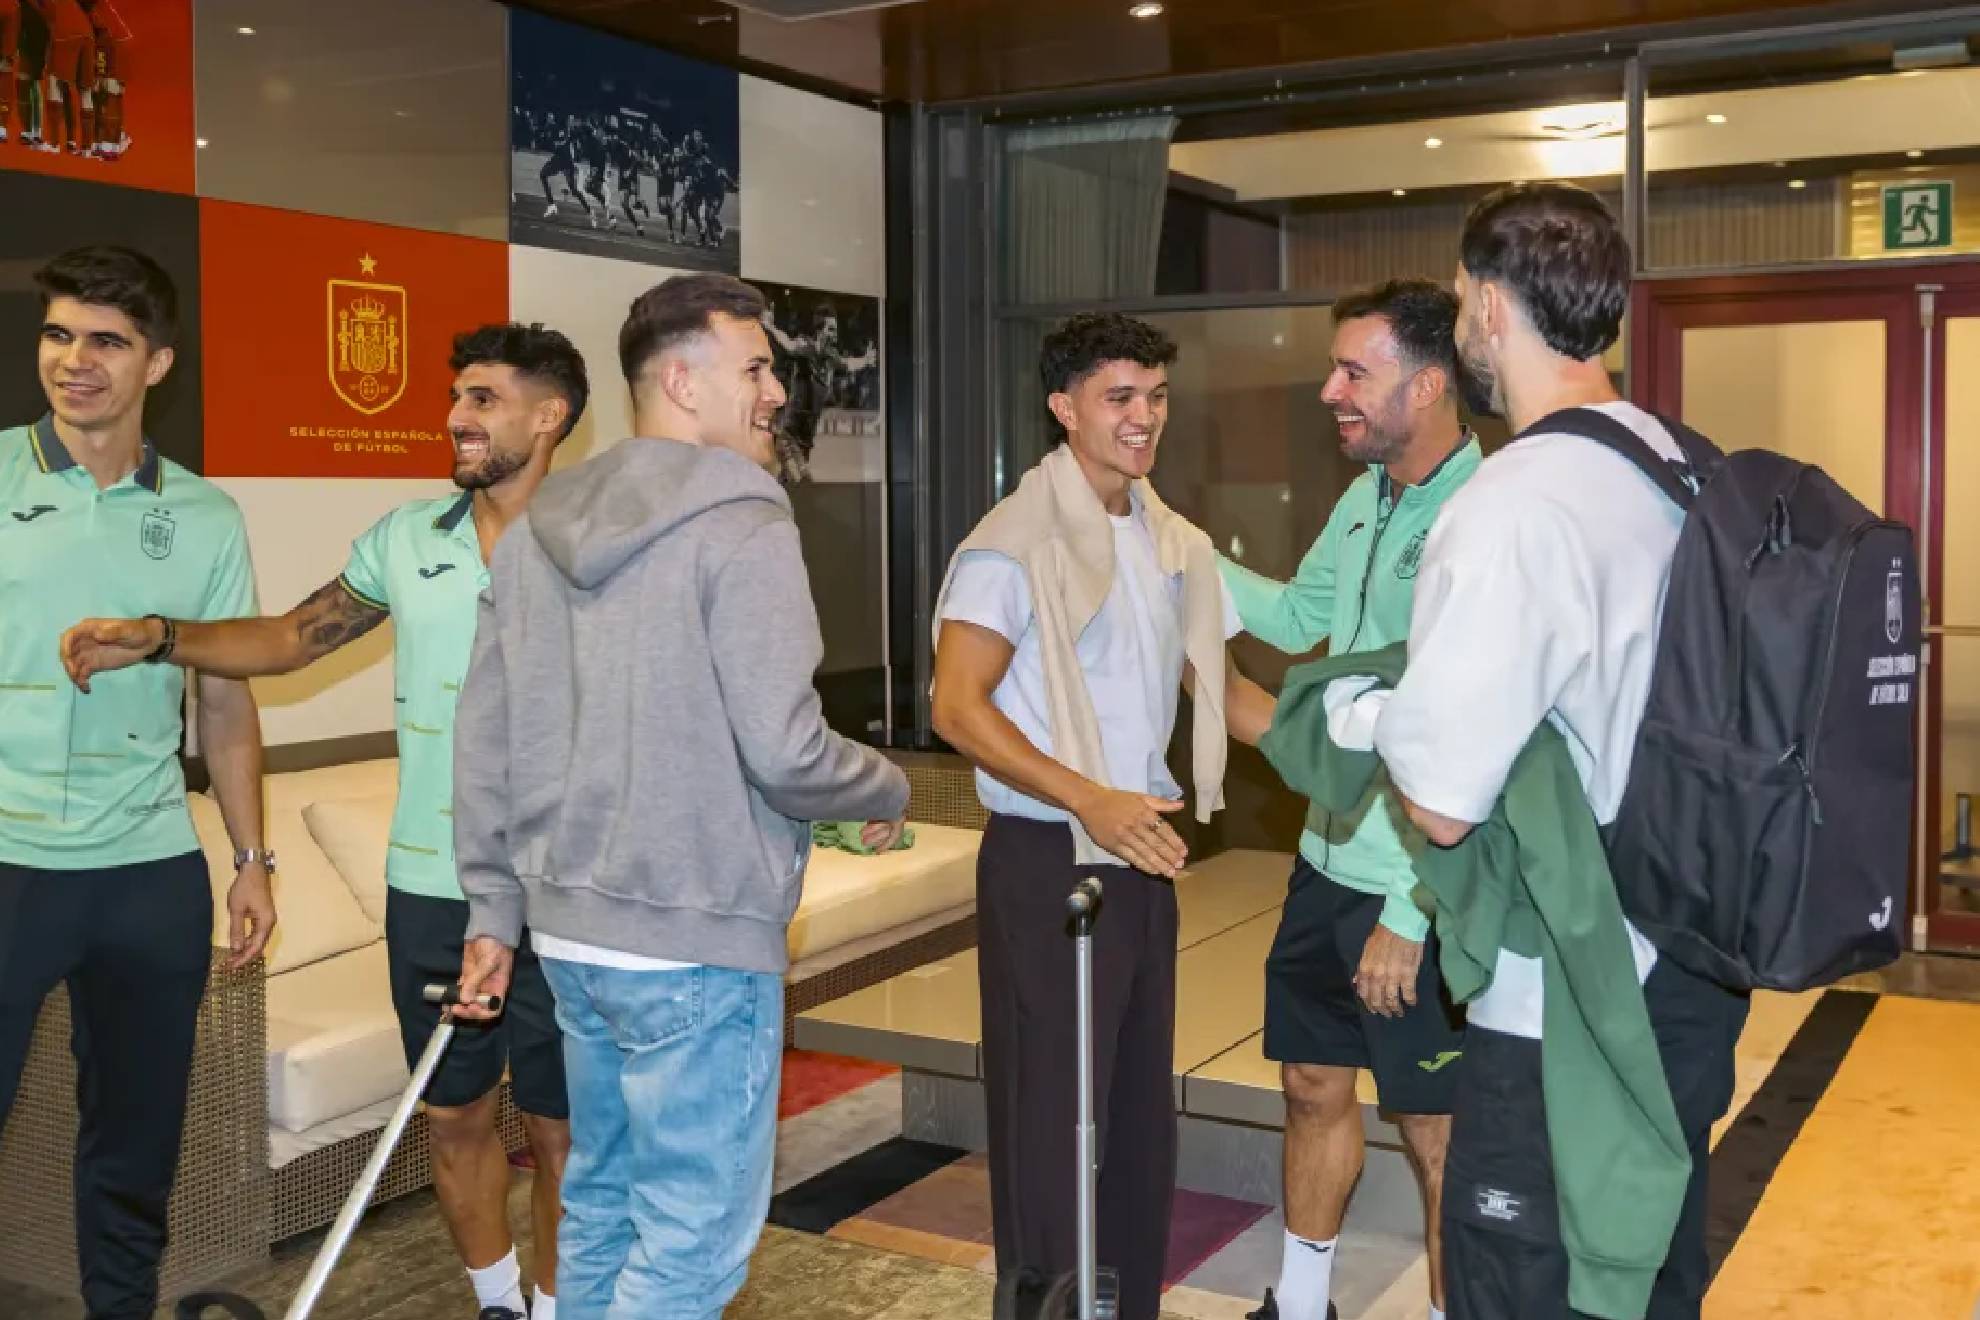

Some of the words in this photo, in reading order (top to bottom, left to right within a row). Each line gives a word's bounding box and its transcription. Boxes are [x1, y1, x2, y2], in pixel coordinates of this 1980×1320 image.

[289, 426, 369, 439] SELECCIÓN
[374, 429, 443, 441] ESPAÑOLA
[334, 442, 352, 452] DE
